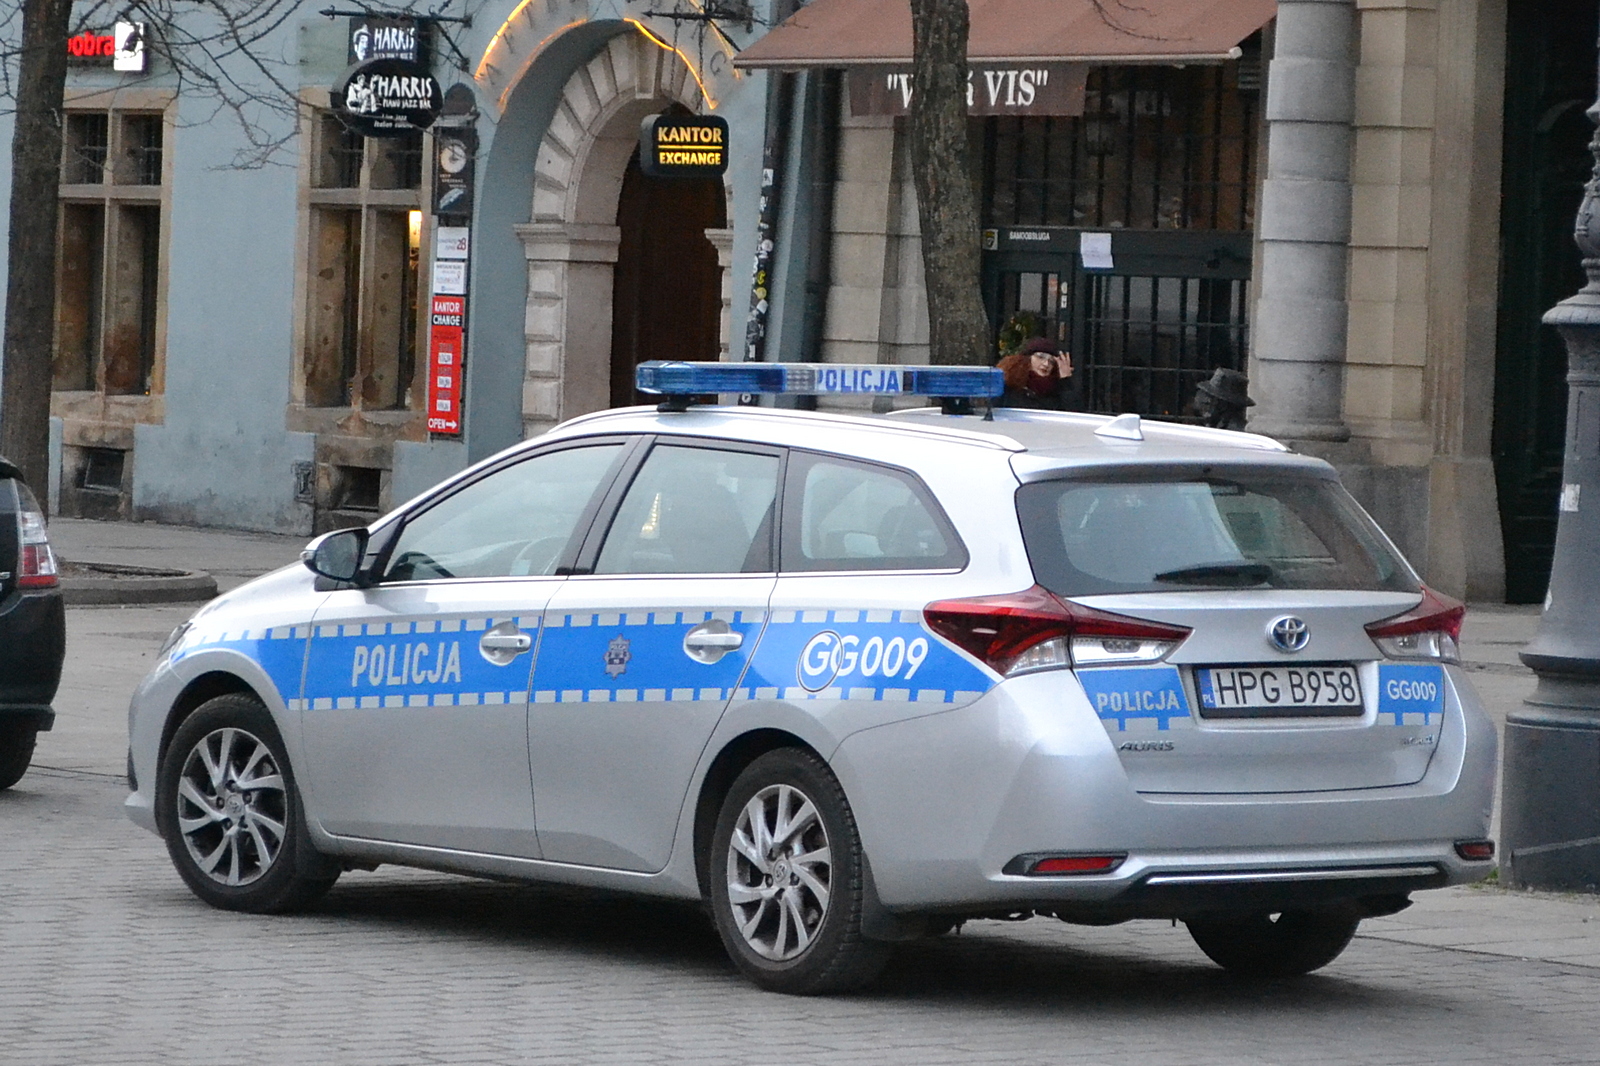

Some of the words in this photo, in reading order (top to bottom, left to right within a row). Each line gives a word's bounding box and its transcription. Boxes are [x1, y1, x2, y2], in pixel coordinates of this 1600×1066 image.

[373, 26, 415, 51] HARRIS
[377, 76, 432, 98] HARRIS
[402, 99, 418, 109] JAZZ
[658, 126, 723, 143] KANTOR
[659, 152, 722, 165] EXCHANGE
[434, 301, 461, 313] KANTOR
[432, 315, 461, 326] CHANGE
[816, 369, 900, 393] POLICJA
[427, 418, 446, 429] OPEN
[351, 641, 462, 688] POLICJA
[802, 634, 928, 680] GG009
[1216, 670, 1281, 705] HPG
[1288, 670, 1356, 704] B958
[1387, 679, 1437, 702] GG009
[1096, 689, 1180, 713] POLICJA
[1202, 694, 1214, 704] PL
[1119, 741, 1176, 752] AURIS
